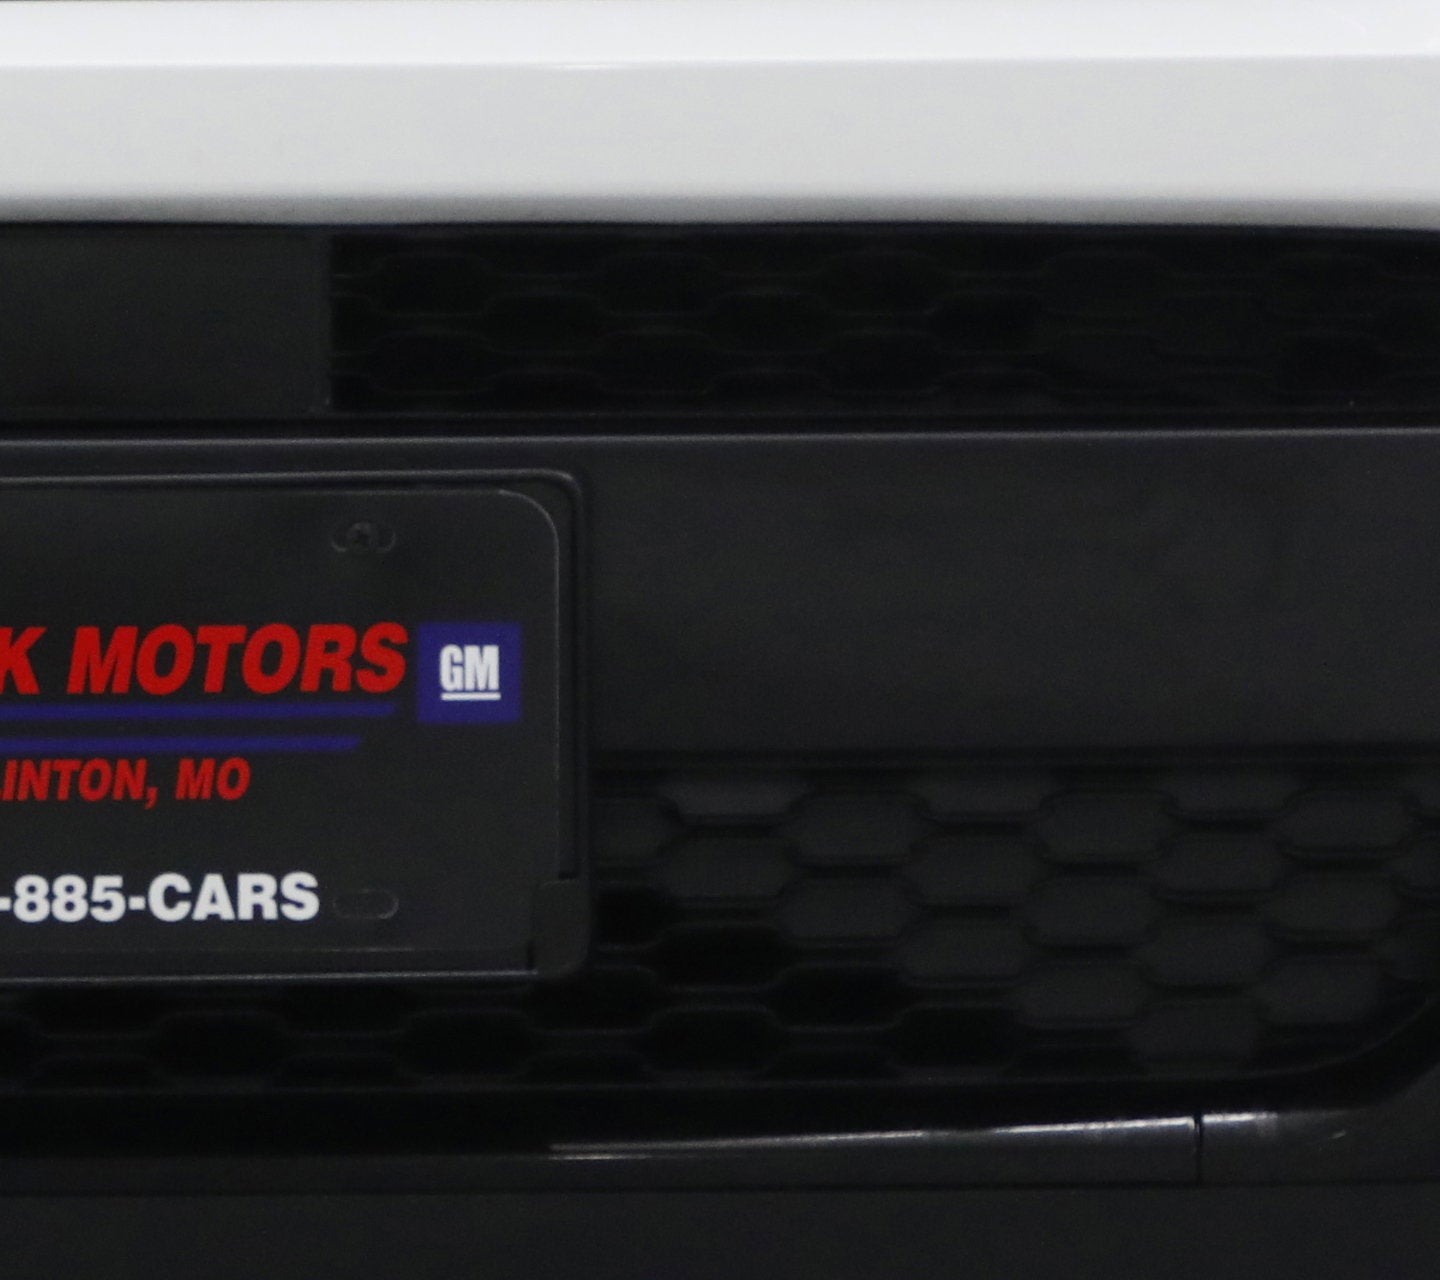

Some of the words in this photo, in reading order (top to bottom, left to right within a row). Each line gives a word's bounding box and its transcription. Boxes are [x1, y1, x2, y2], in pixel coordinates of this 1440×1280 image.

[66, 621, 409, 696] MOTORS
[439, 643, 500, 692] GM
[175, 756, 252, 801] MO
